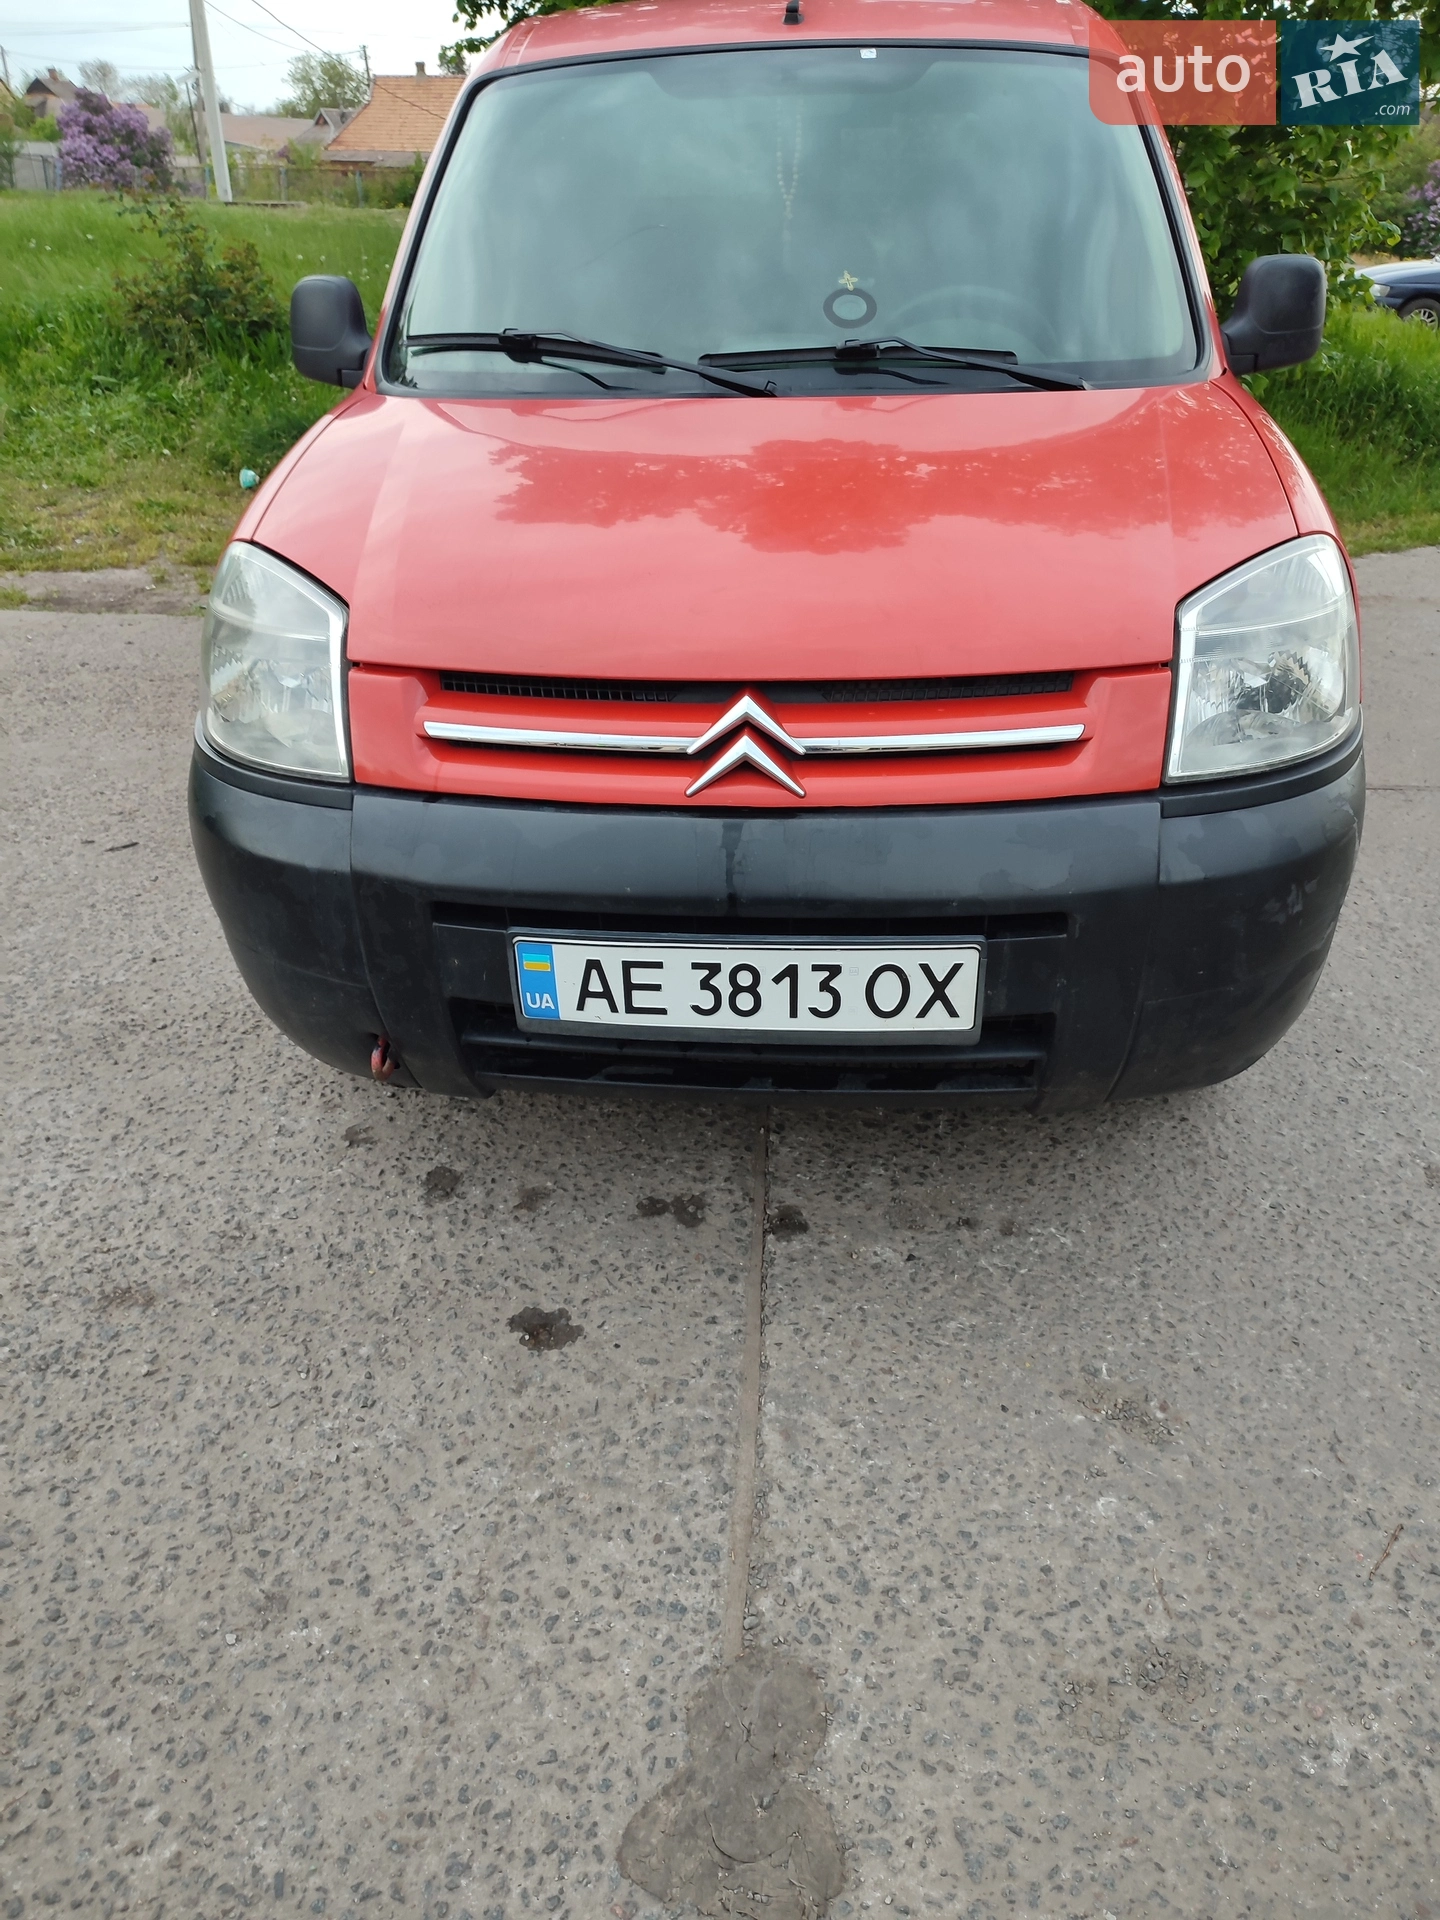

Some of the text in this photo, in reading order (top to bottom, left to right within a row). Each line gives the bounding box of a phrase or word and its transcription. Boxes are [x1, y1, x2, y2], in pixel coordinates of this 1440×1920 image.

[525, 991, 556, 1011] UA
[575, 958, 965, 1019] AE 3813 OX
